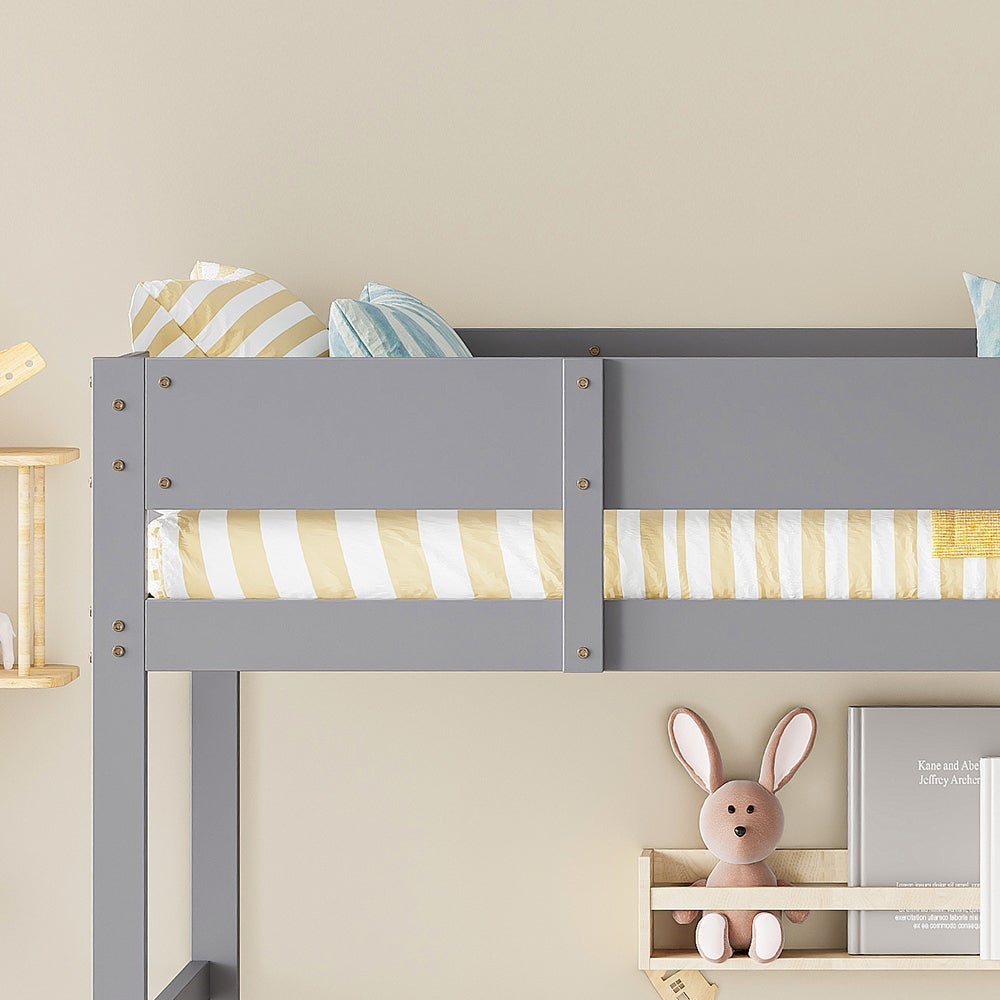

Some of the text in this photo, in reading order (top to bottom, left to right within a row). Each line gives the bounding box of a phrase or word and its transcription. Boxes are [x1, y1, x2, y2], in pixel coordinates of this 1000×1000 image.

[918, 759, 980, 771] Kane and Abe
[918, 773, 949, 787] Jeffrey
